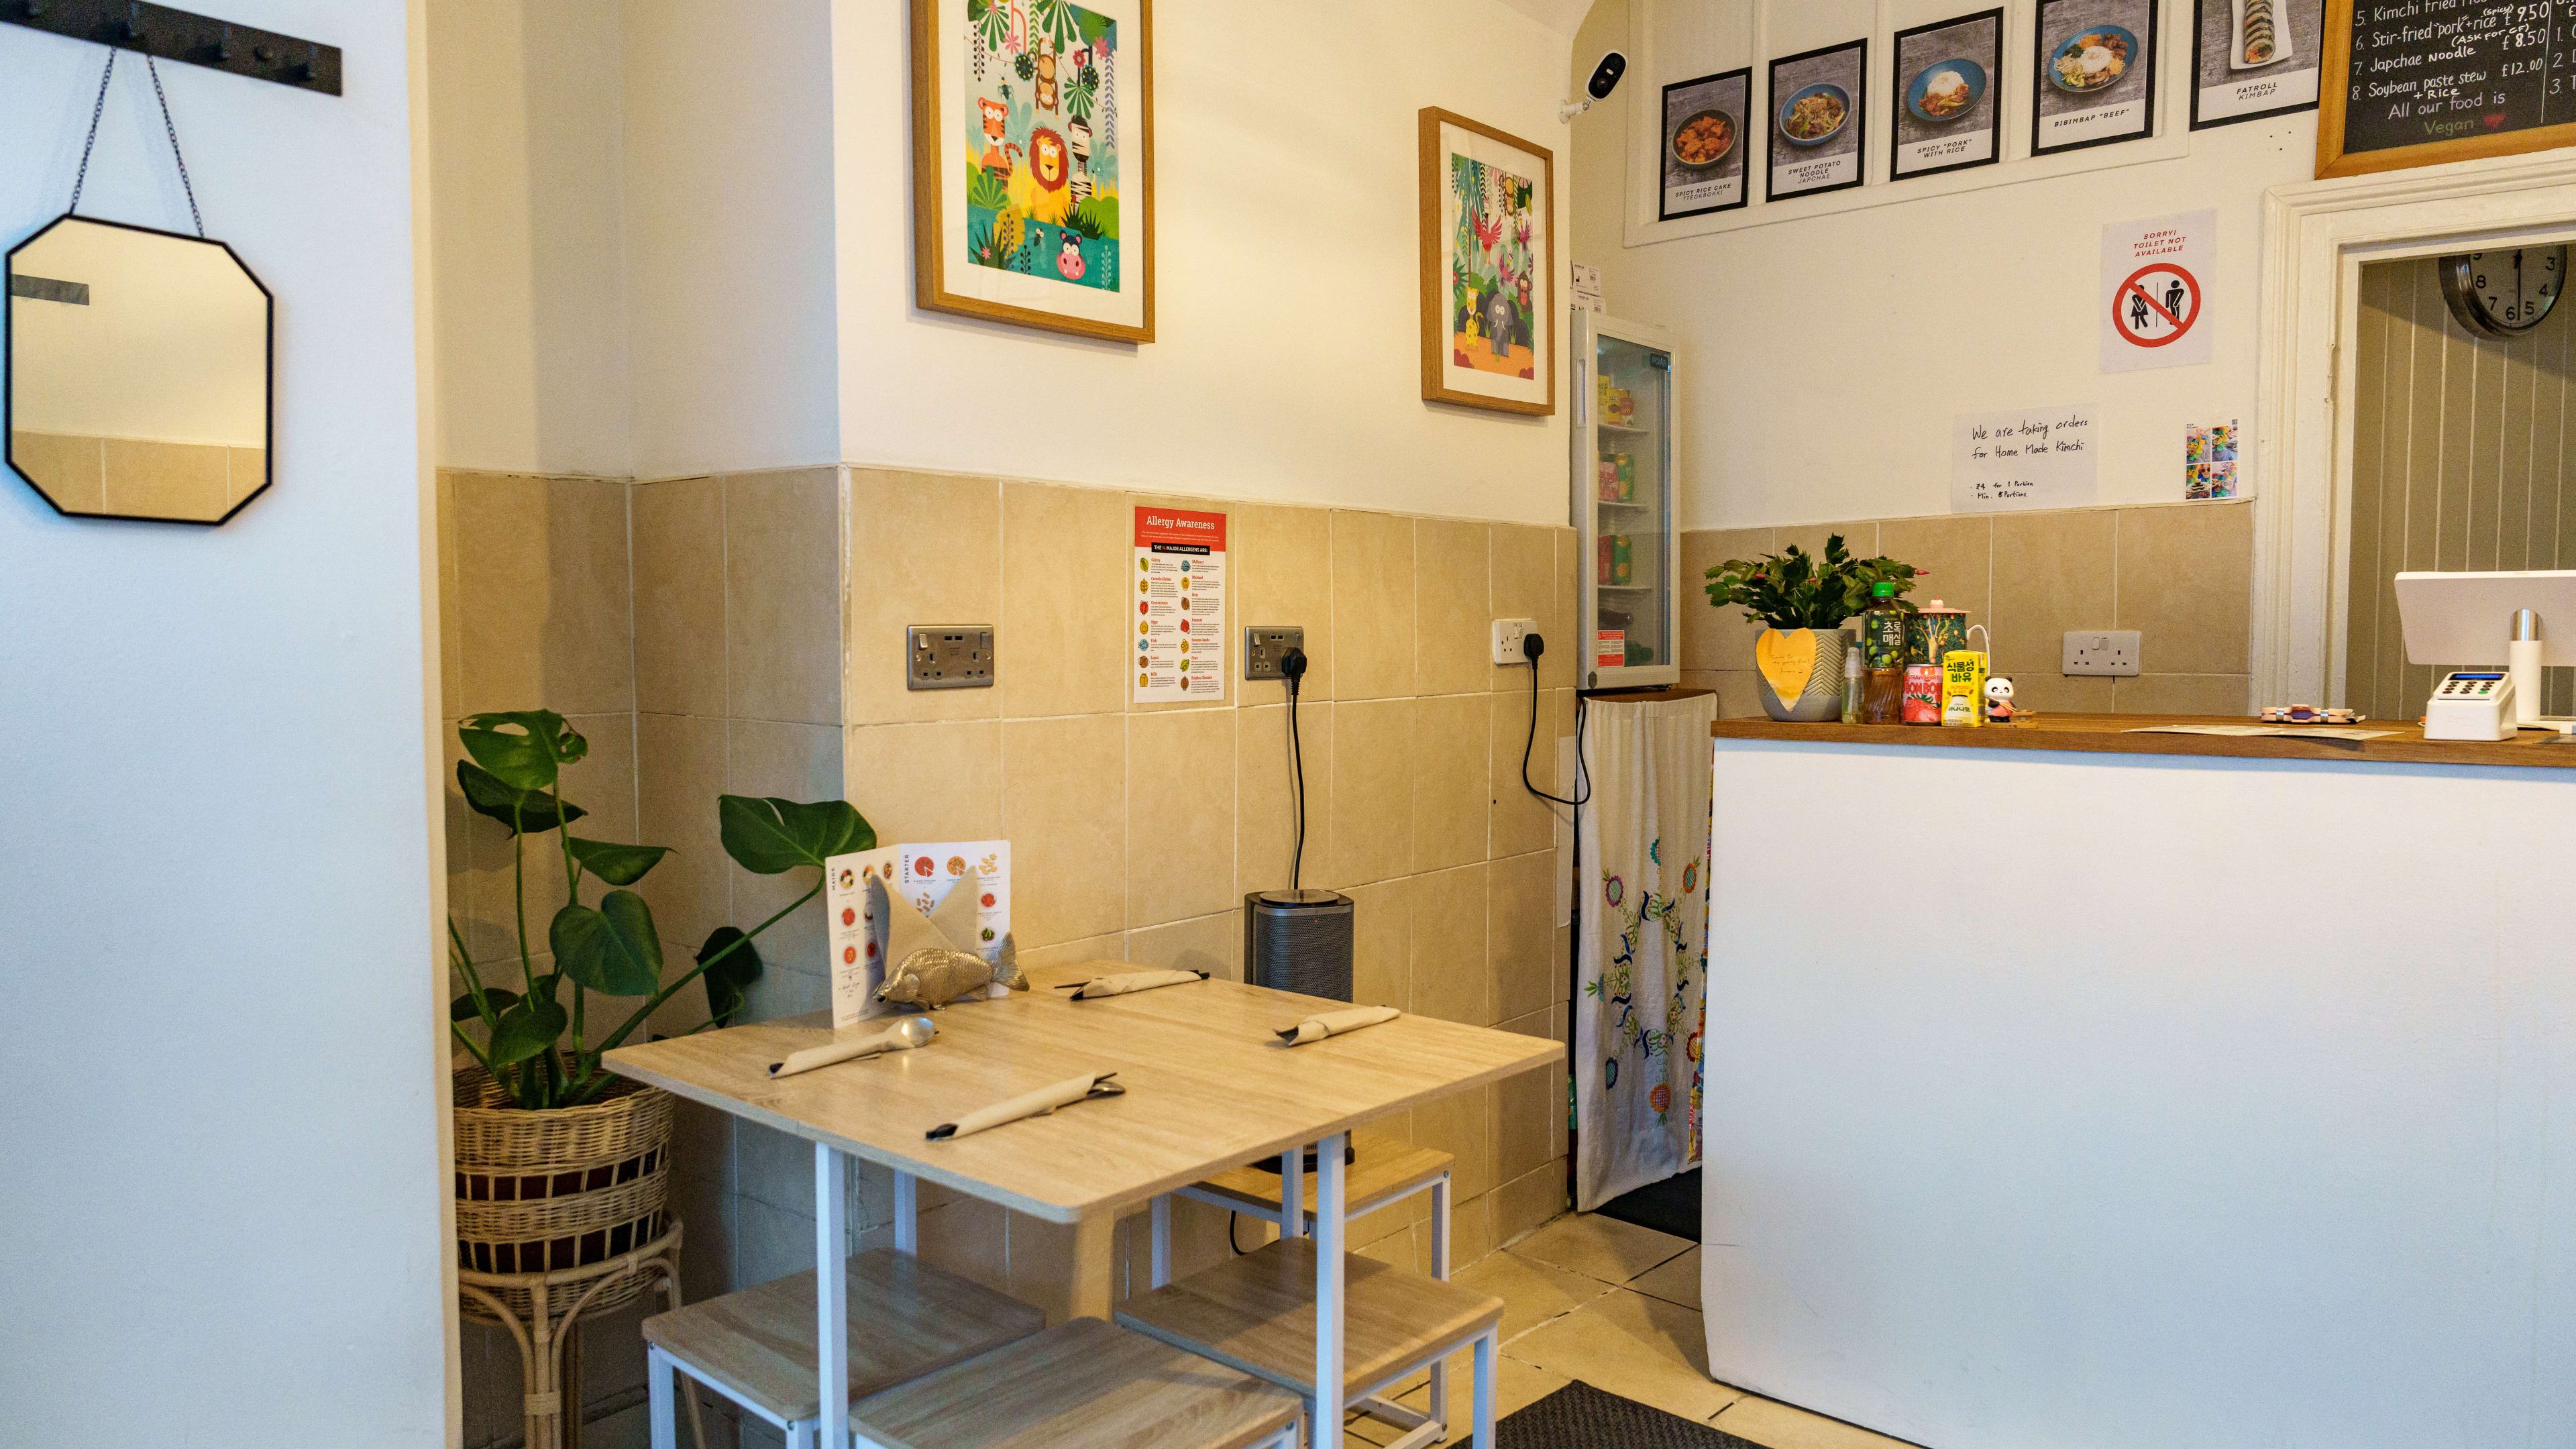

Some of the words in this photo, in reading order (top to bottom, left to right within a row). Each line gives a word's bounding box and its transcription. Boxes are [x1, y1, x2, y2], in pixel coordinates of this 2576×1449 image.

[2355, 10, 2366, 26] 5.
[2374, 0, 2418, 21] Kimchi
[2483, 3, 2514, 17] (Spicy)
[2355, 35, 2365, 51] 6.
[2372, 21, 2432, 48] Stir-fried
[2517, 1, 2549, 22] 9.50
[2451, 34, 2482, 48] (ASK
[2508, 23, 2530, 34] GF)
[2354, 62, 2363, 76] 7.
[2370, 53, 2422, 72] Japchae
[2515, 28, 2546, 48] 8.50
[2237, 81, 2278, 95] FATROLL
[2352, 85, 2361, 101] 8.
[2368, 80, 2417, 98] Soybean
[2423, 74, 2454, 92] paste
[2458, 70, 2487, 85] stew
[2239, 89, 2275, 100] KIMBAP
[2427, 88, 2461, 100] Rice
[2387, 102, 2410, 120] All
[2418, 101, 2443, 115] our
[2449, 92, 2483, 111] food
[2493, 91, 2506, 105] is
[2054, 115, 2096, 127] BIBIMBAP
[2424, 119, 2475, 136] Vegan
[1917, 144, 1941, 154] SPICY
[1924, 150, 1943, 158] WITH
[1946, 146, 1966, 154] RICE
[1788, 166, 1812, 174] SWEET
[1814, 160, 1841, 170] POTATO
[1799, 168, 1829, 178] NOODLE
[1798, 173, 1831, 184] JAPCHAE
[1675, 189, 1694, 197] SPICY
[1682, 190, 1723, 201] TTEOKBOKKI
[2143, 229, 2177, 239] SORRY!
[2134, 239, 2165, 250] TOILET
[2167, 236, 2187, 244] NOT
[2135, 245, 2184, 258] AVAILABLE
[2545, 256, 2557, 271] 3
[2475, 274, 2487, 289] 8
[2538, 283, 2548, 298] 4
[2488, 296, 2498, 311] 7
[2524, 301, 2534, 315] 5
[2506, 306, 2516, 321] 6
[1972, 424, 1988, 440] We
[1995, 427, 2014, 438] are
[2018, 419, 2049, 439] taking
[2055, 414, 2088, 430] orders
[1971, 446, 1988, 459] for
[1995, 445, 2019, 458] Home
[2025, 442, 2049, 455] Made
[2055, 439, 2085, 453] Kimchi
[1146, 515, 1174, 529] Allergy
[1175, 517, 1215, 530] Awareness
[1882, 621, 1901, 633] 초록
[1882, 634, 1901, 646] 매실
[1947, 659, 1974, 673] 식물성
[1951, 673, 1972, 683] 바유
